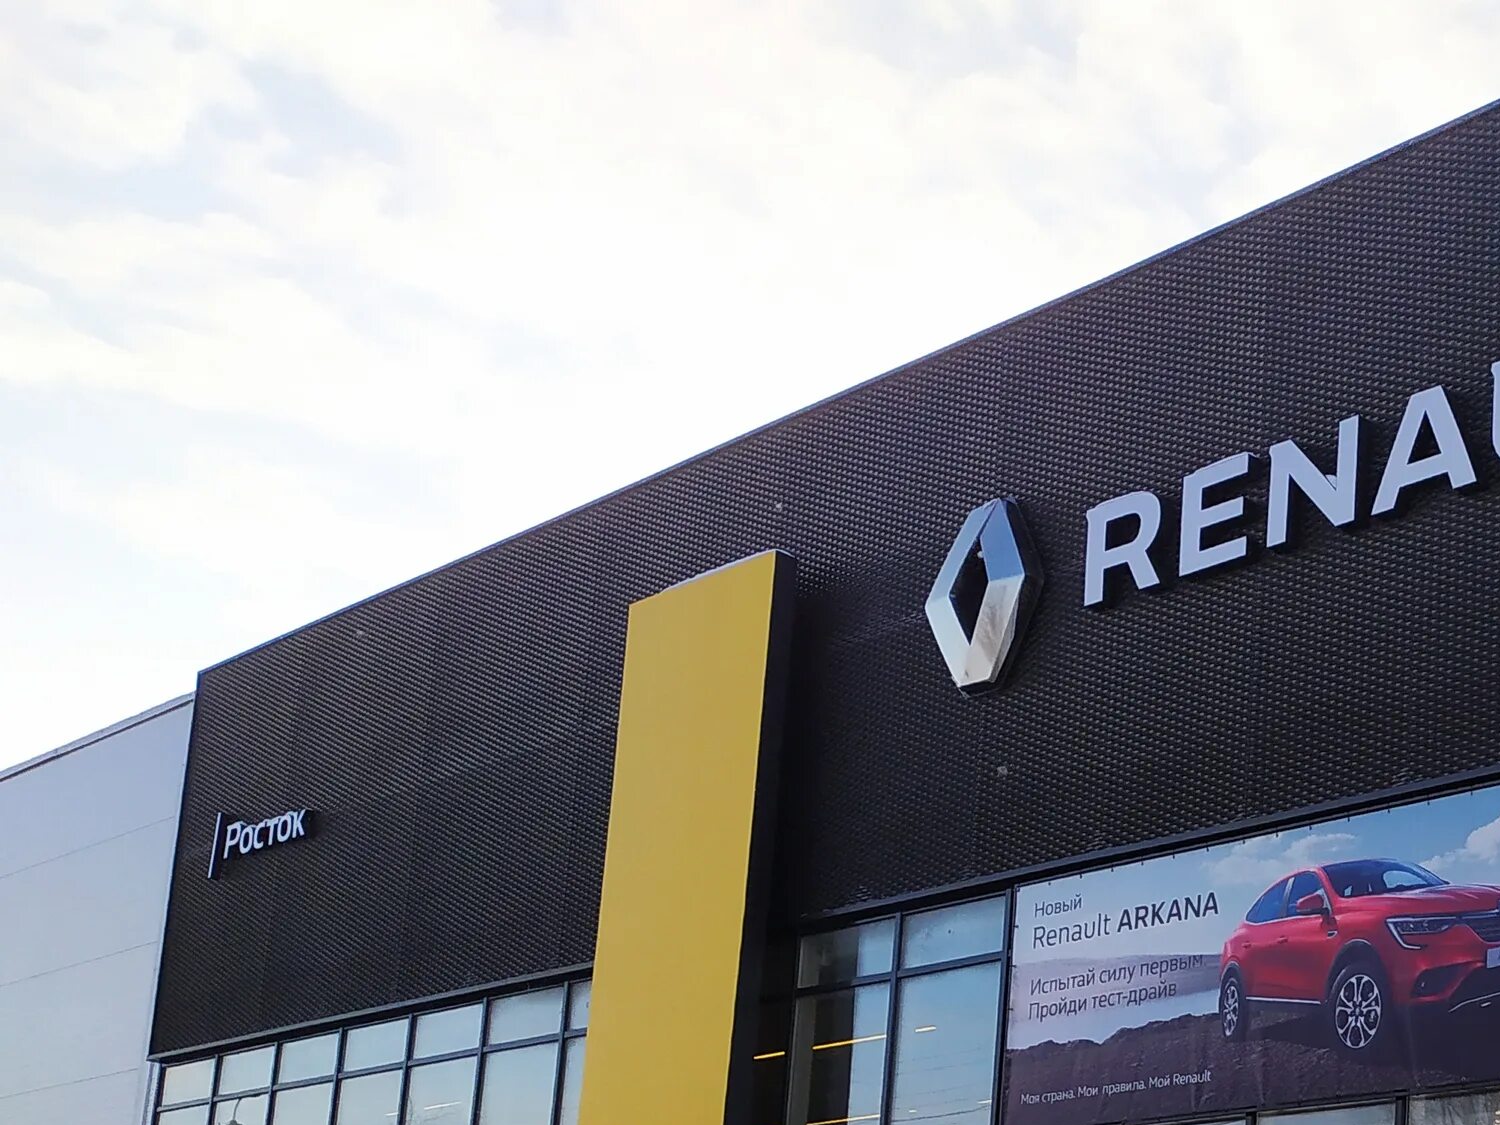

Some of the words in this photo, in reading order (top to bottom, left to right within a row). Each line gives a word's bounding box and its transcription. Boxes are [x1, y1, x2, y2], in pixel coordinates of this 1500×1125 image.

[1033, 912, 1111, 949] Renault
[1117, 892, 1219, 933] ARKANA
[1034, 894, 1082, 918] Новый
[1030, 968, 1095, 996] Испытай
[1099, 964, 1136, 984] силу
[1028, 997, 1087, 1023] Пройди
[1091, 981, 1177, 1009] тест-драйв
[1021, 1092, 1039, 1105] Моя
[1077, 1085, 1099, 1098] Мои
[1149, 1074, 1170, 1088] Мой
[1173, 1069, 1212, 1085] Renault
